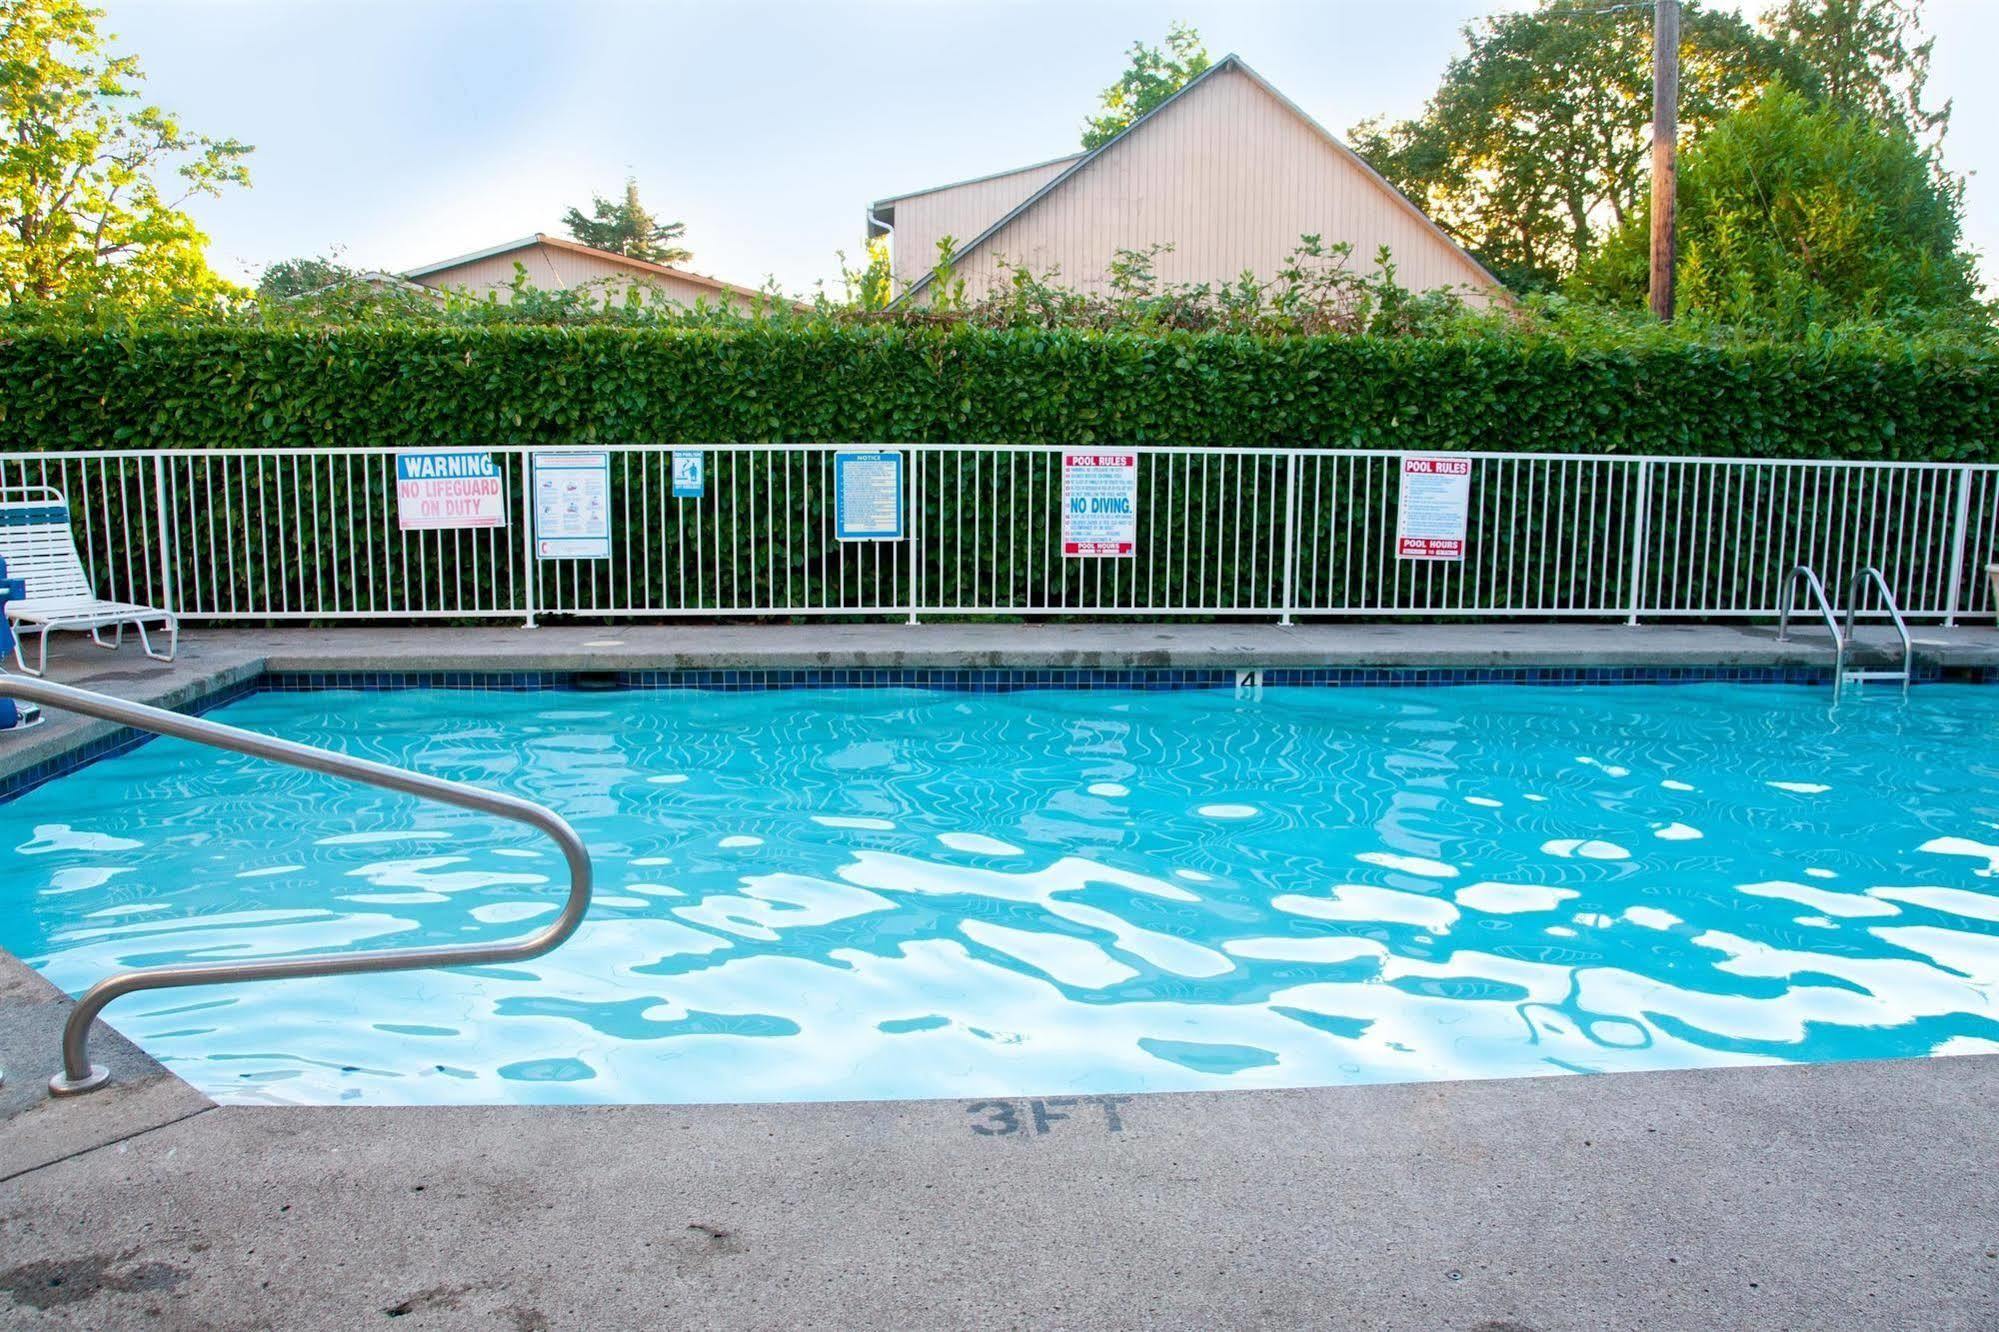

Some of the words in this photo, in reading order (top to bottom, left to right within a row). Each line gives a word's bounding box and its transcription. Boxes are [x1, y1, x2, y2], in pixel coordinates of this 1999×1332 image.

[404, 455, 493, 478] WARNING
[1072, 456, 1095, 466] POOL
[1099, 456, 1127, 466] RULES
[1406, 461, 1432, 472] POOL
[1435, 462, 1467, 474] RULES
[401, 481, 419, 498] NO
[425, 479, 499, 497] LIFEGUARD
[421, 500, 439, 516] ON
[446, 499, 481, 516] DUTY
[1071, 497, 1086, 513] NO
[1404, 539, 1427, 548] POOL
[1430, 540, 1458, 549] HOURS
[1241, 671, 1257, 687] 4
